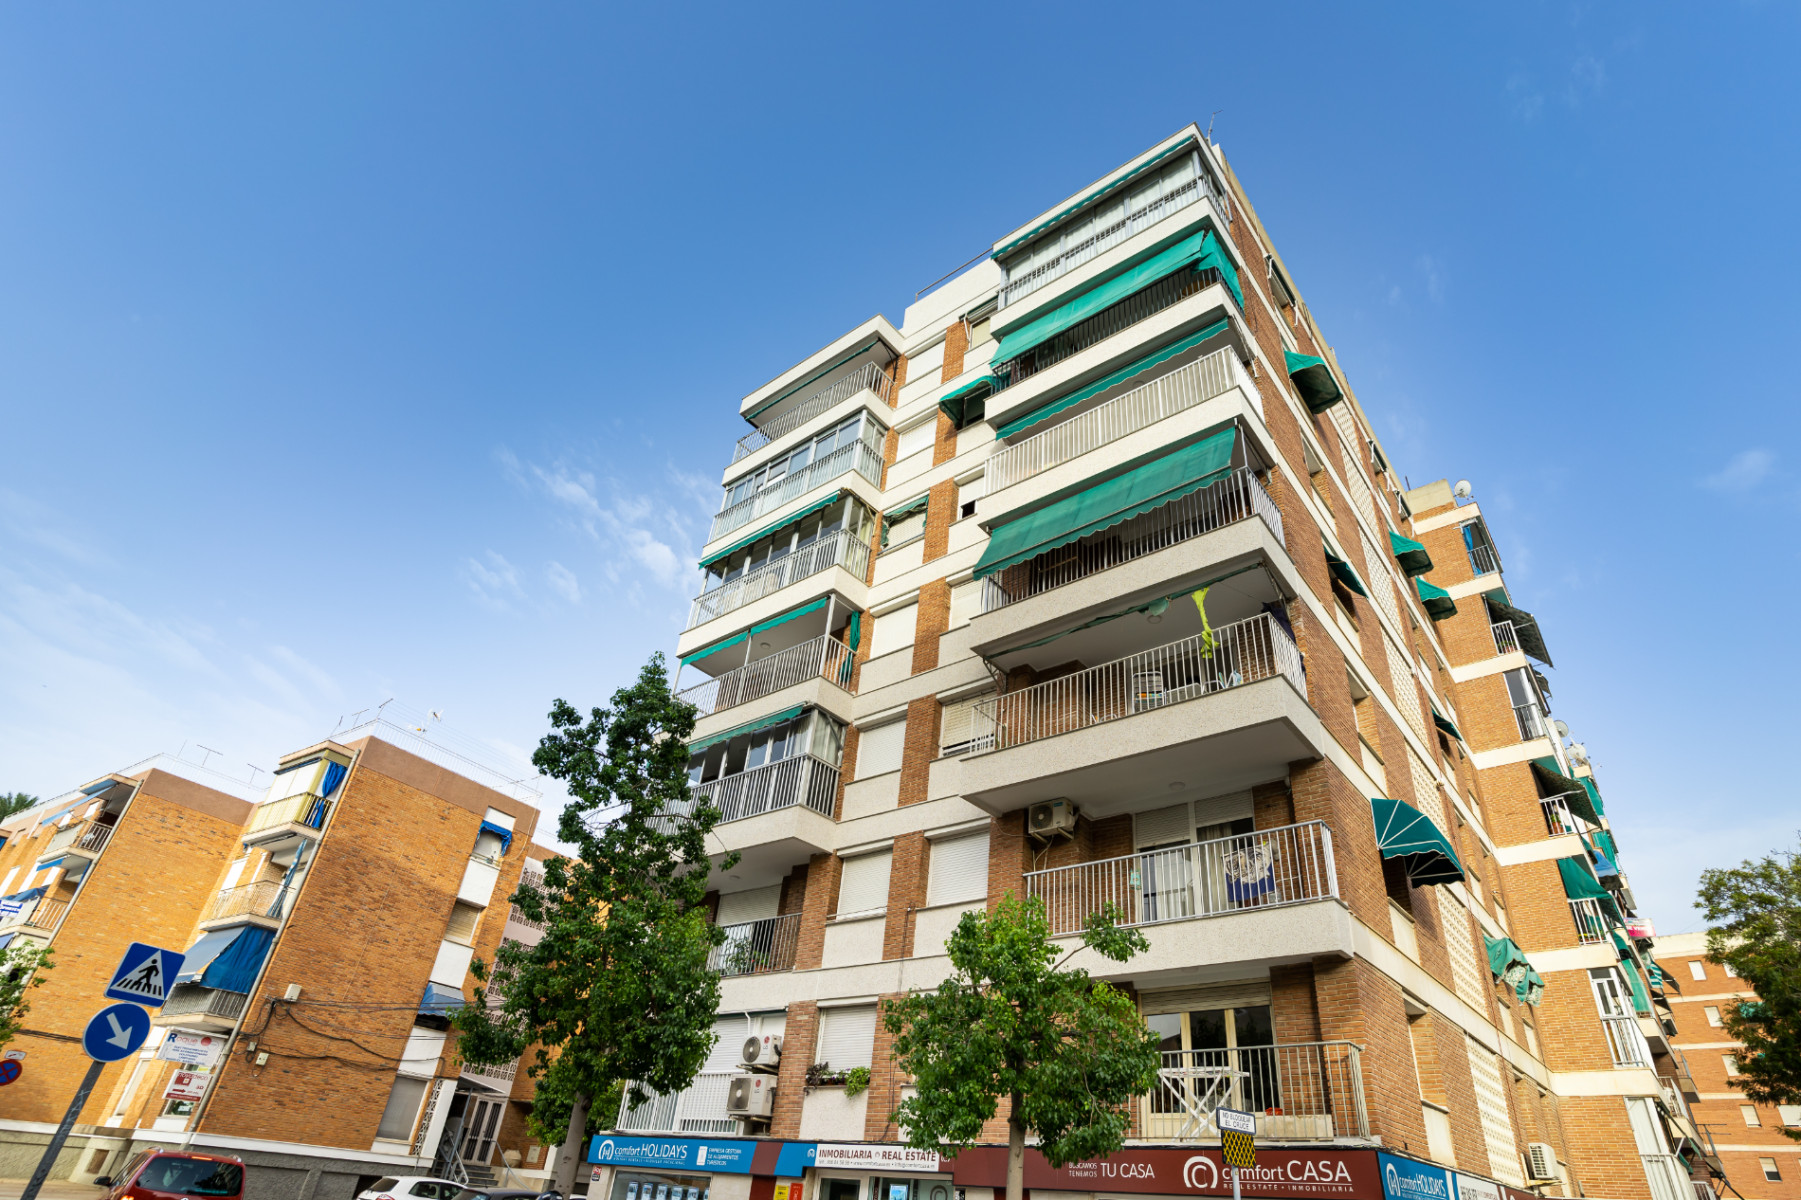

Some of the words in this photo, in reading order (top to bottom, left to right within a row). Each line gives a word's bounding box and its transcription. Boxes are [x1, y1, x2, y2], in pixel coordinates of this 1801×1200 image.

[167, 1033, 199, 1044] Roque
[1222, 1111, 1229, 1119] NO
[1232, 1120, 1249, 1130] CRUCE
[614, 1145, 640, 1156] comfort
[640, 1143, 688, 1159] HOLIDAYS
[818, 1149, 873, 1160] INMOBILIARIA
[881, 1150, 903, 1161] REAL
[905, 1151, 936, 1162] ESTATE
[1068, 1170, 1098, 1178] TENEMOS
[1100, 1162, 1117, 1178] TU
[1120, 1163, 1155, 1179] CASA
[1286, 1160, 1352, 1182] CASA
[1223, 1183, 1244, 1191] REL
[1288, 1185, 1354, 1193] INMOBILIARIA
[1415, 1172, 1447, 1198] HOLIDAYS
